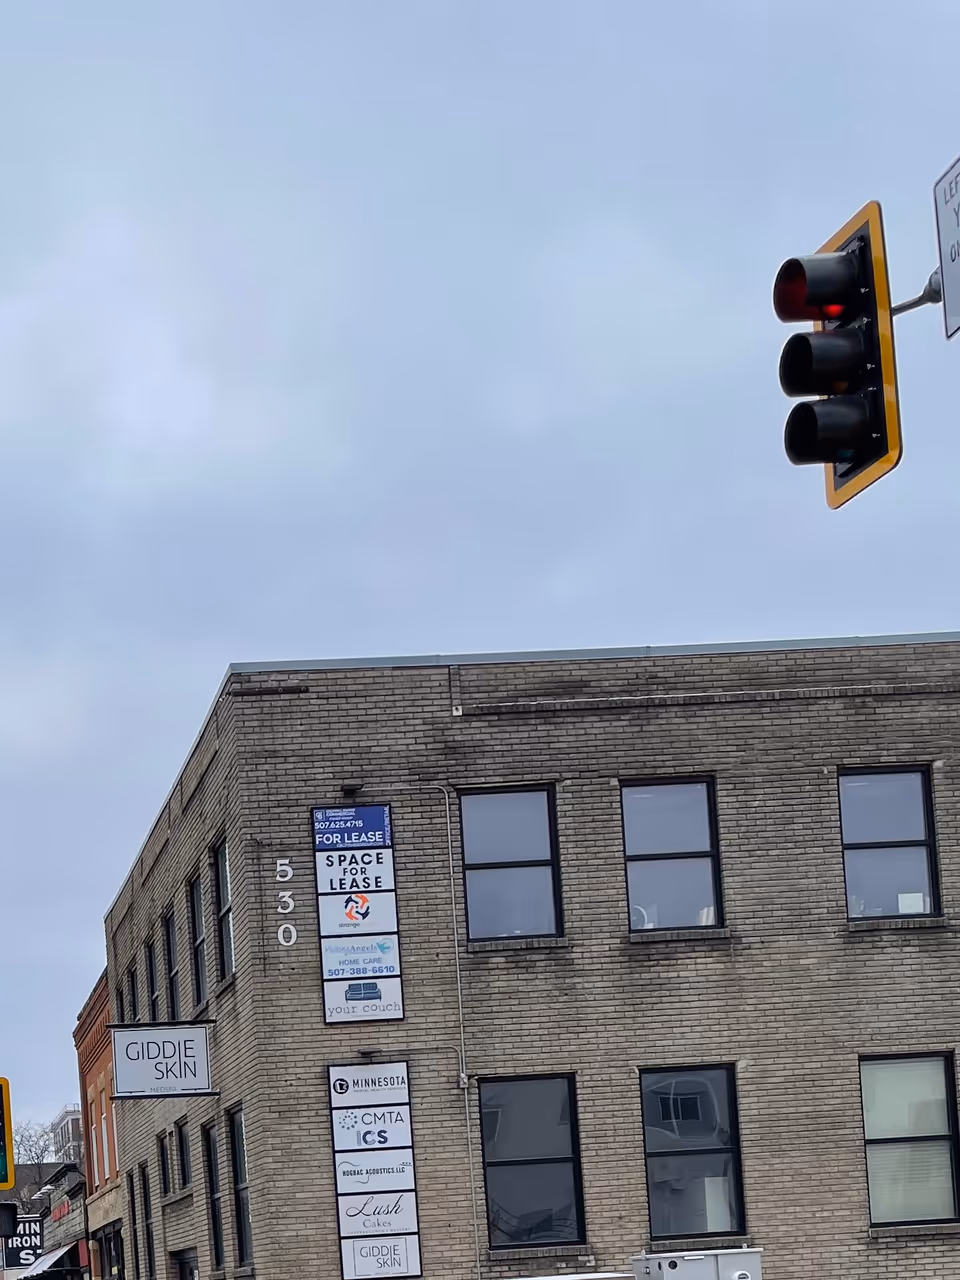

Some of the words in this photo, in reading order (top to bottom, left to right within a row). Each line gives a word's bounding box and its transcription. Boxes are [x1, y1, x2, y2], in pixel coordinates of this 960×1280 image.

[315, 820, 364, 829] 507.625.4715
[315, 834, 342, 845] FOR
[344, 831, 384, 843] LEASE
[326, 852, 384, 867] SPACE
[343, 867, 367, 876] FOR
[330, 876, 382, 891] LEASE
[338, 958, 360, 966] HOME
[362, 957, 383, 965] CARE
[328, 1006, 357, 1017] your
[363, 1002, 400, 1013] couch
[125, 1040, 196, 1061] GIDDIE
[154, 1060, 197, 1080] SKIN
[352, 1076, 406, 1089] MINNESOTA
[361, 1111, 404, 1125] CMTA
[356, 1129, 388, 1146] ICS
[345, 1194, 404, 1218] Lush
[362, 1218, 392, 1228] Cakes
[8, 1235, 40, 1248] IRON
[360, 1244, 401, 1258] GIDDIE
[376, 1257, 402, 1269] SKIN
